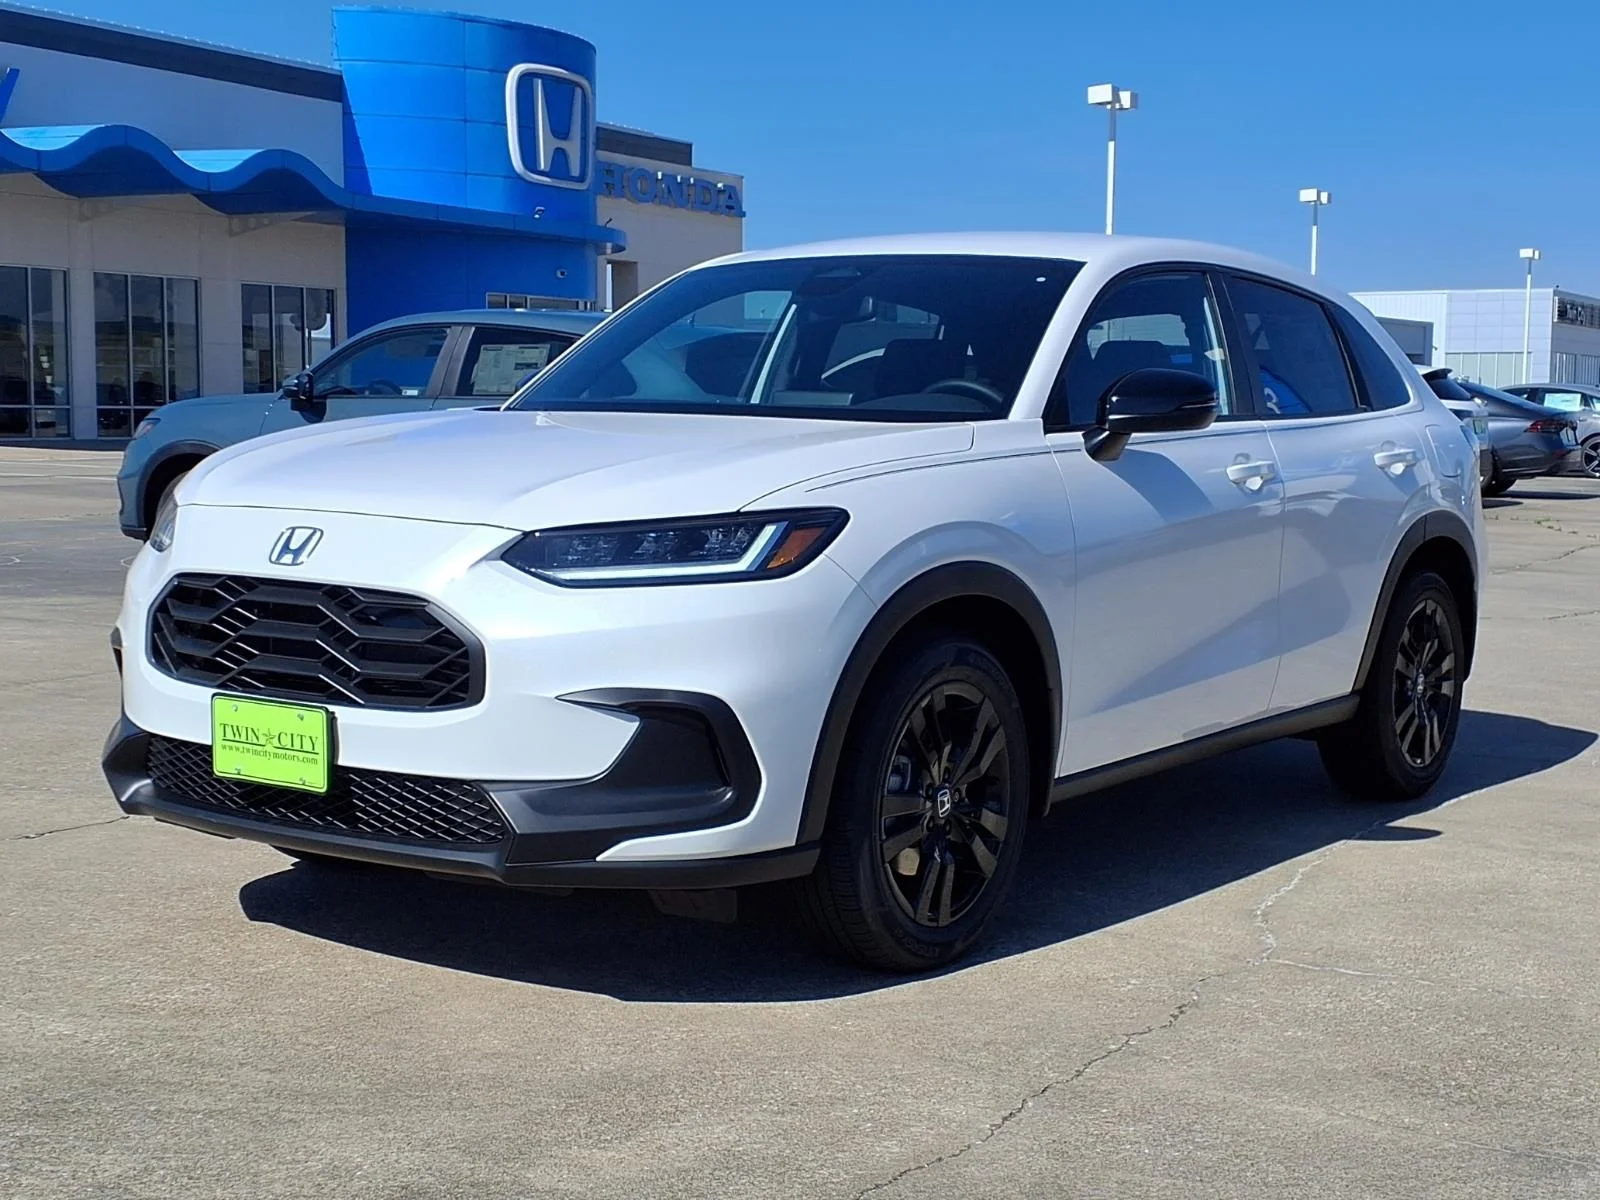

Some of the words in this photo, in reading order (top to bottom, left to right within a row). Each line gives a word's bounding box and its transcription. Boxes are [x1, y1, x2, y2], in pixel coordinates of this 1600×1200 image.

[596, 160, 745, 217] HONDA
[219, 722, 260, 743] TWIN
[277, 731, 318, 751] CITY
[221, 743, 318, 765] www.twincitymotors.com
